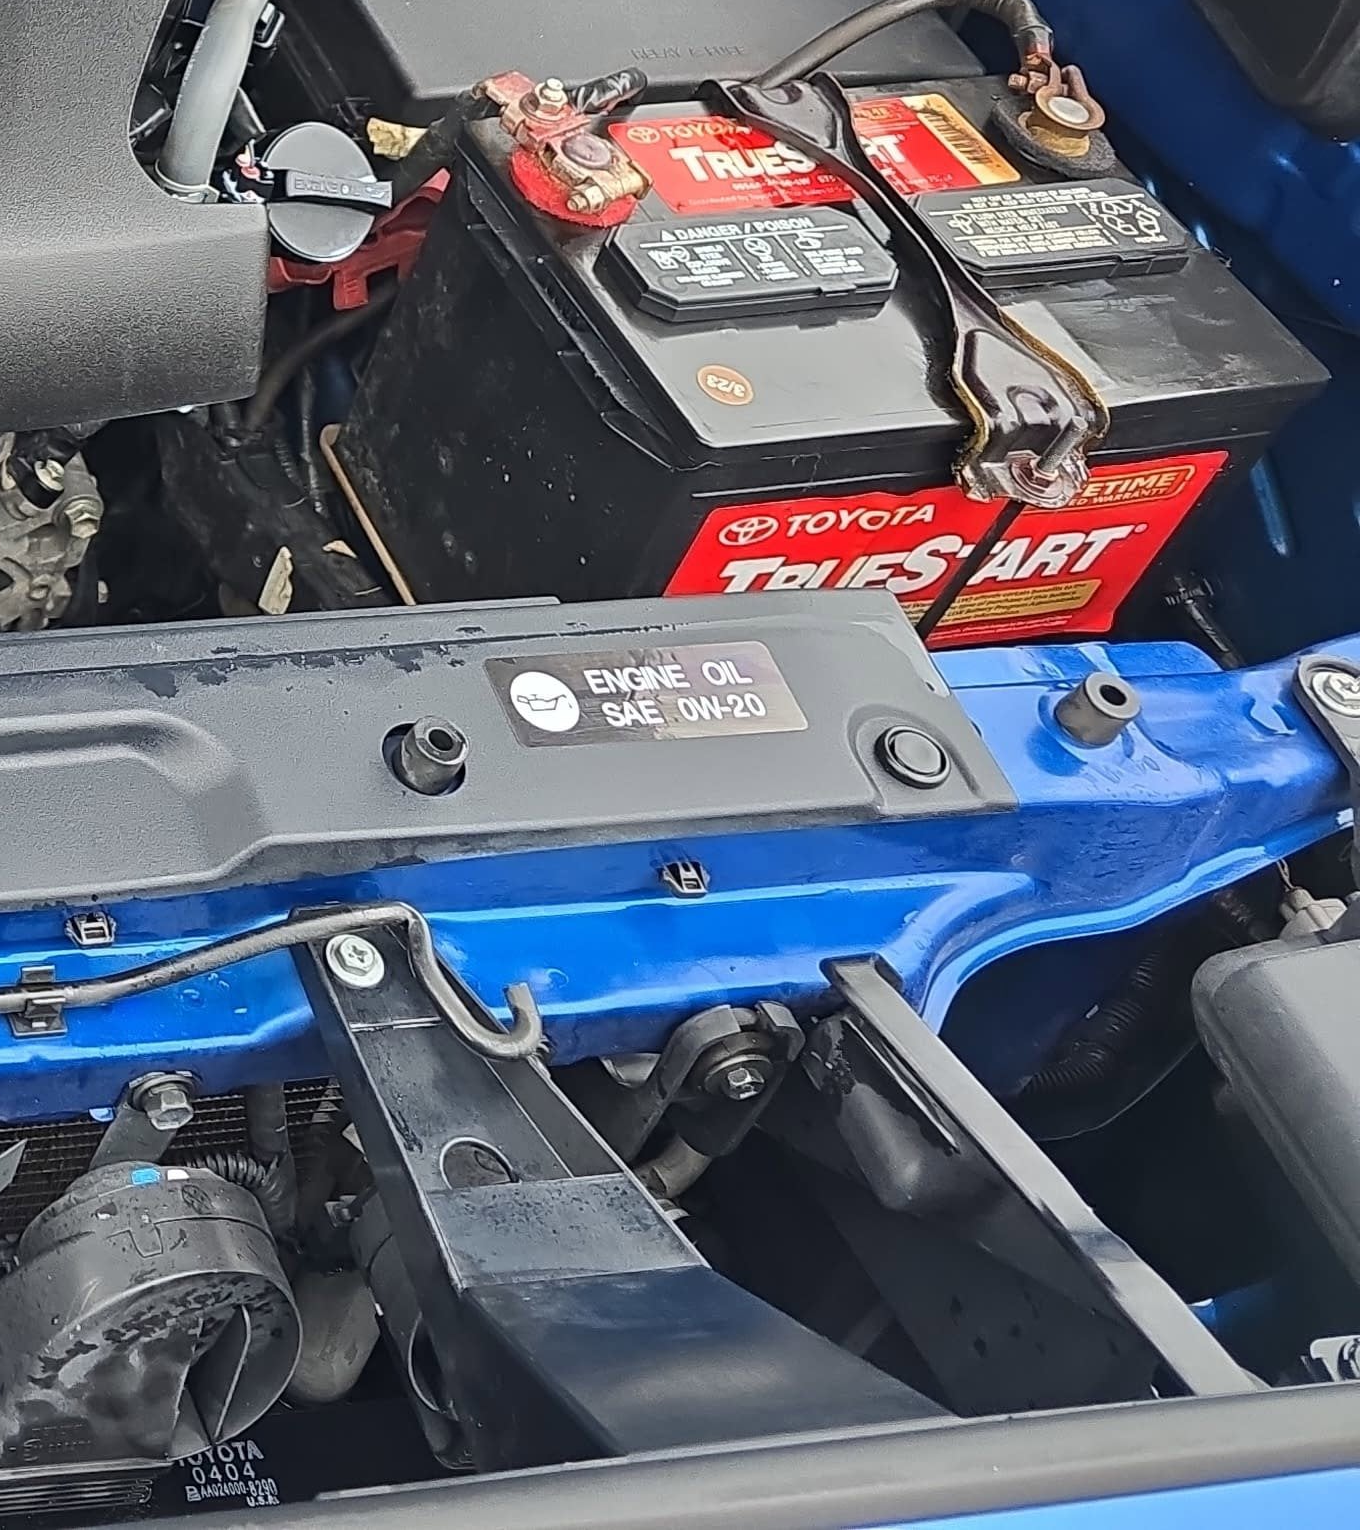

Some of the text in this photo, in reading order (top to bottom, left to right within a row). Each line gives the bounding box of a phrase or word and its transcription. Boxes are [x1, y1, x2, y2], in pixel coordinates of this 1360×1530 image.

[674, 223, 742, 242] DANGER
[755, 216, 815, 232] POISON
[706, 374, 746, 398] 3/23
[1093, 486, 1171, 505] WARRANTY
[787, 504, 935, 538] TOYOTA
[584, 660, 753, 695] ENGINE OIL
[601, 692, 767, 728] SAE 0W-20
[192, 1461, 256, 1484] 0404
